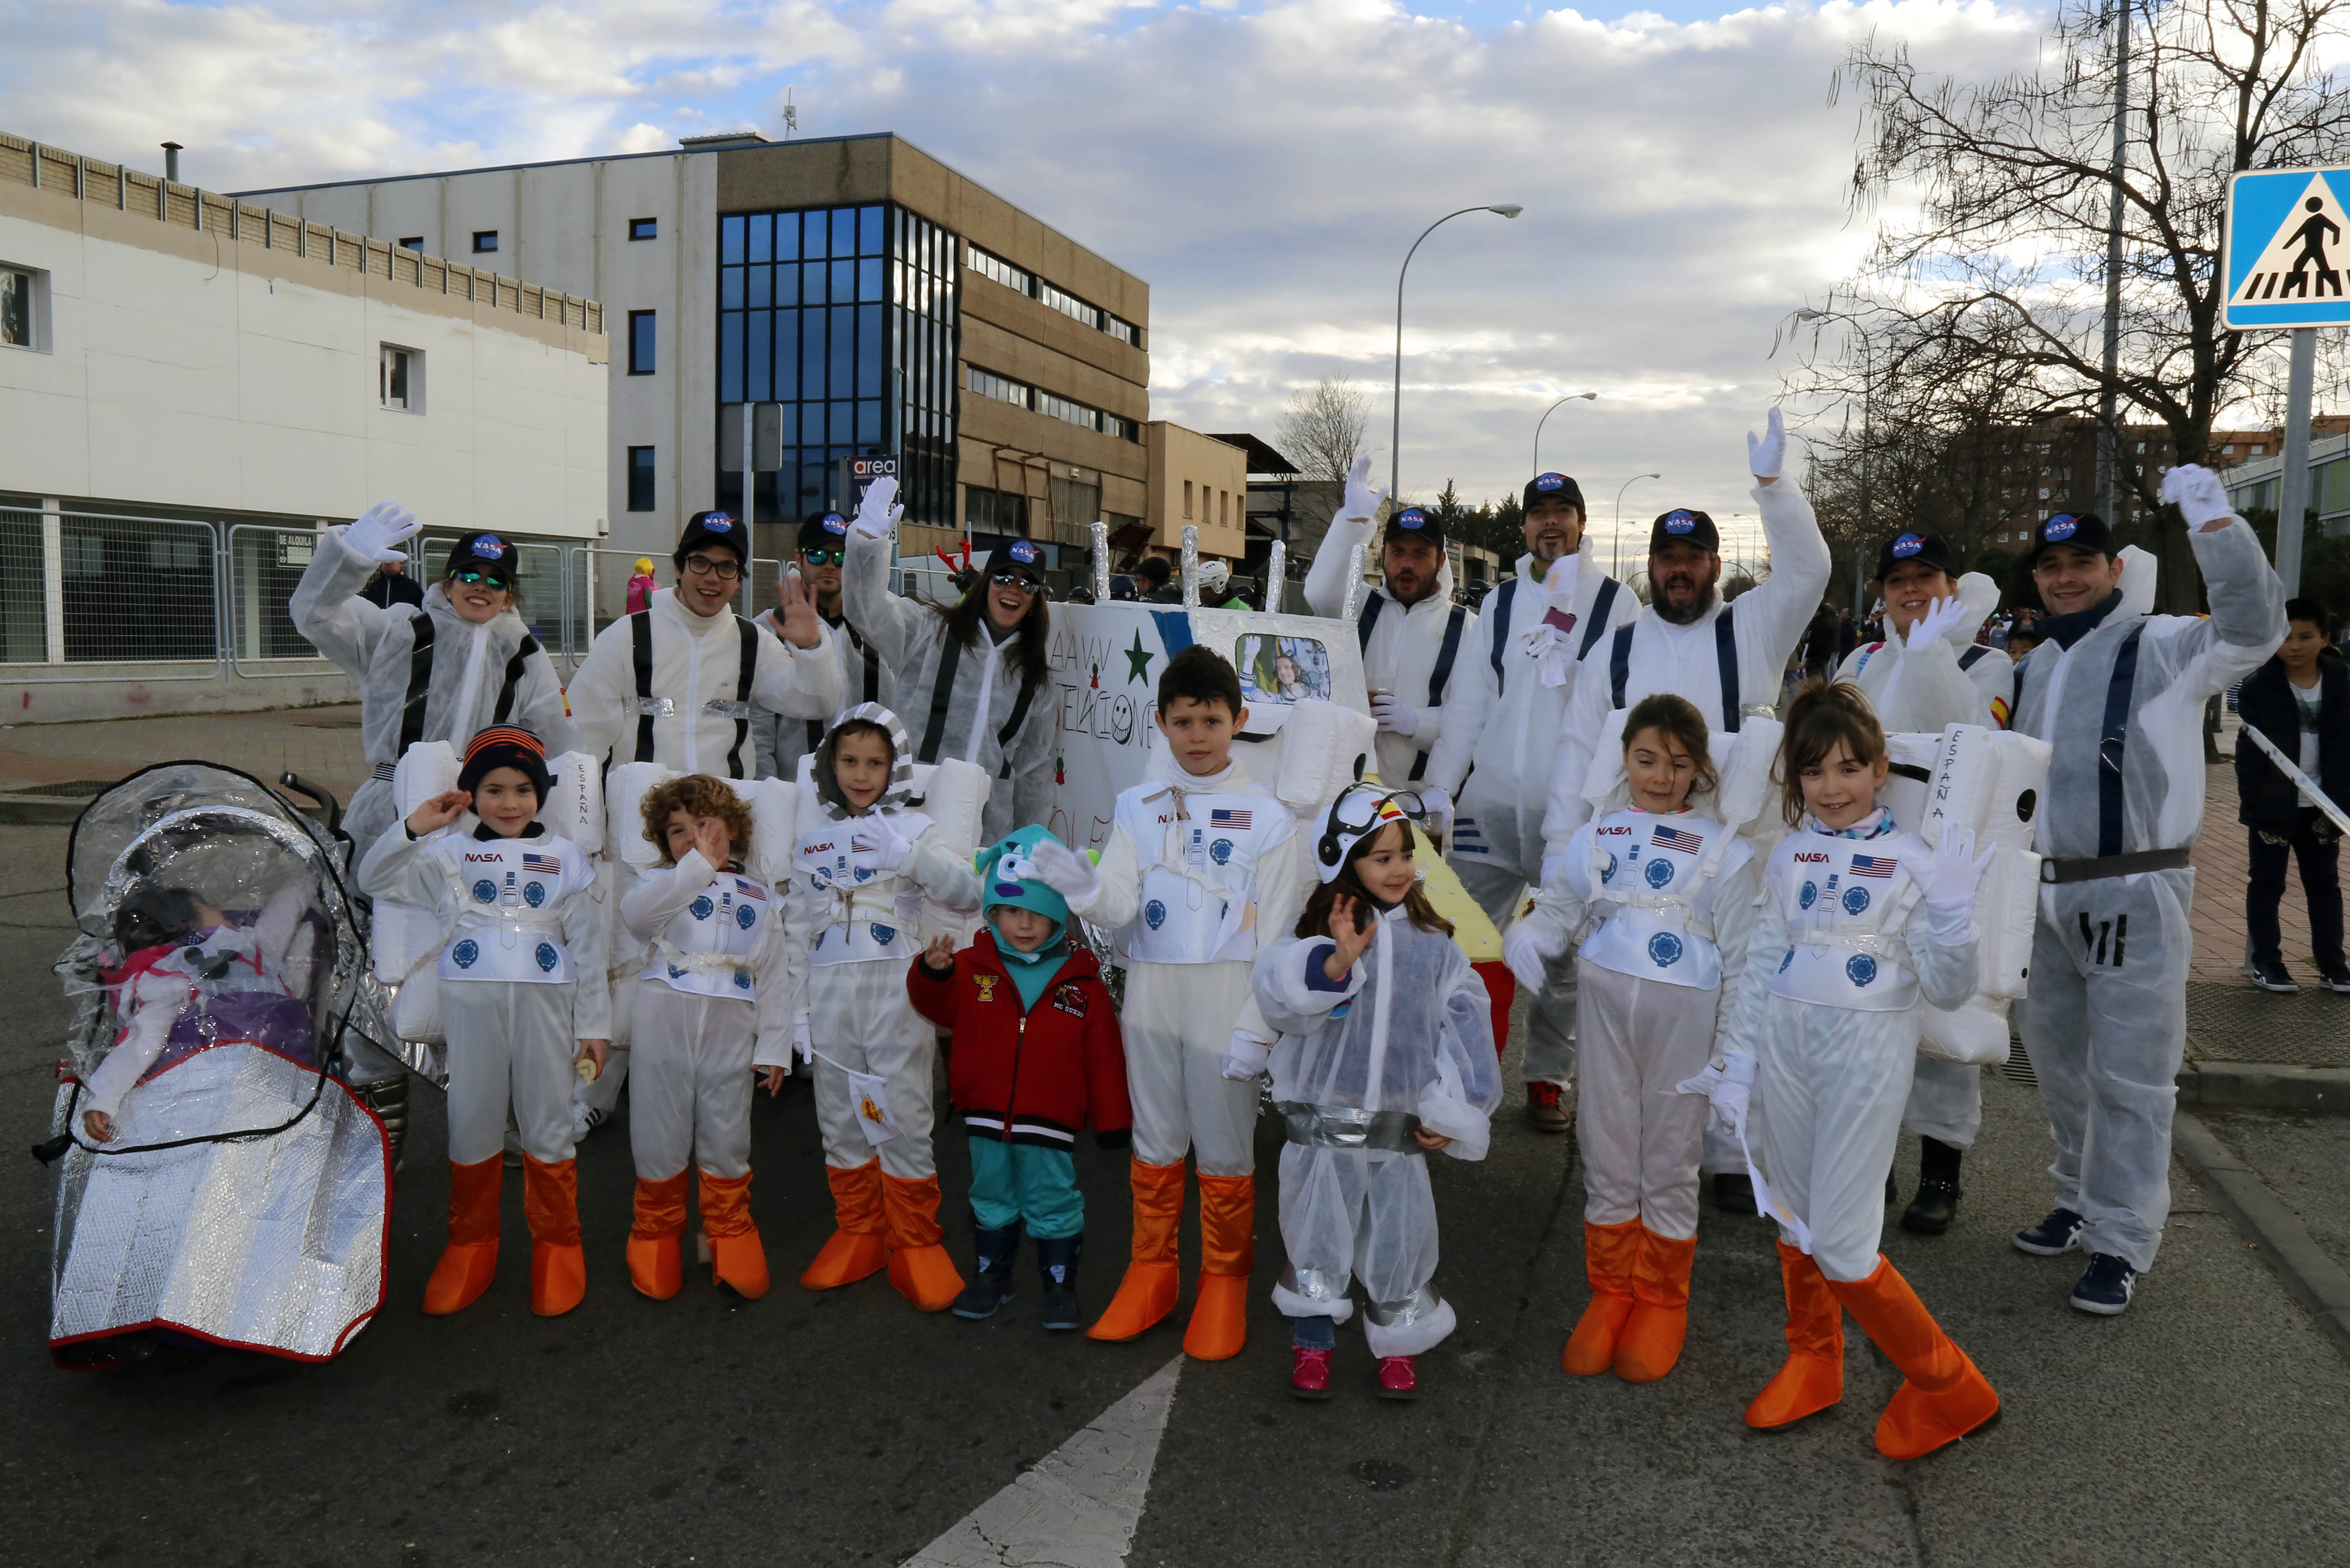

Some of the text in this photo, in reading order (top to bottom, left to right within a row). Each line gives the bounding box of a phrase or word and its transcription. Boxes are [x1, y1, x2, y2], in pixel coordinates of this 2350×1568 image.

[854, 460, 895, 474] area
[705, 518, 731, 527] NASA
[824, 520, 846, 531] NASA
[2047, 523, 2075, 535] NASA
[279, 535, 312, 546] SE ALQUILA
[1894, 542, 1921, 551] NASA
[475, 542, 502, 554] NASA
[1012, 547, 1034, 559] NASA
[1932, 731, 1963, 818] ESPAÑA
[579, 765, 588, 824] ESPAÑA
[804, 843, 835, 855] NASA
[465, 853, 503, 862] NASA
[1794, 853, 1829, 863] NASA
